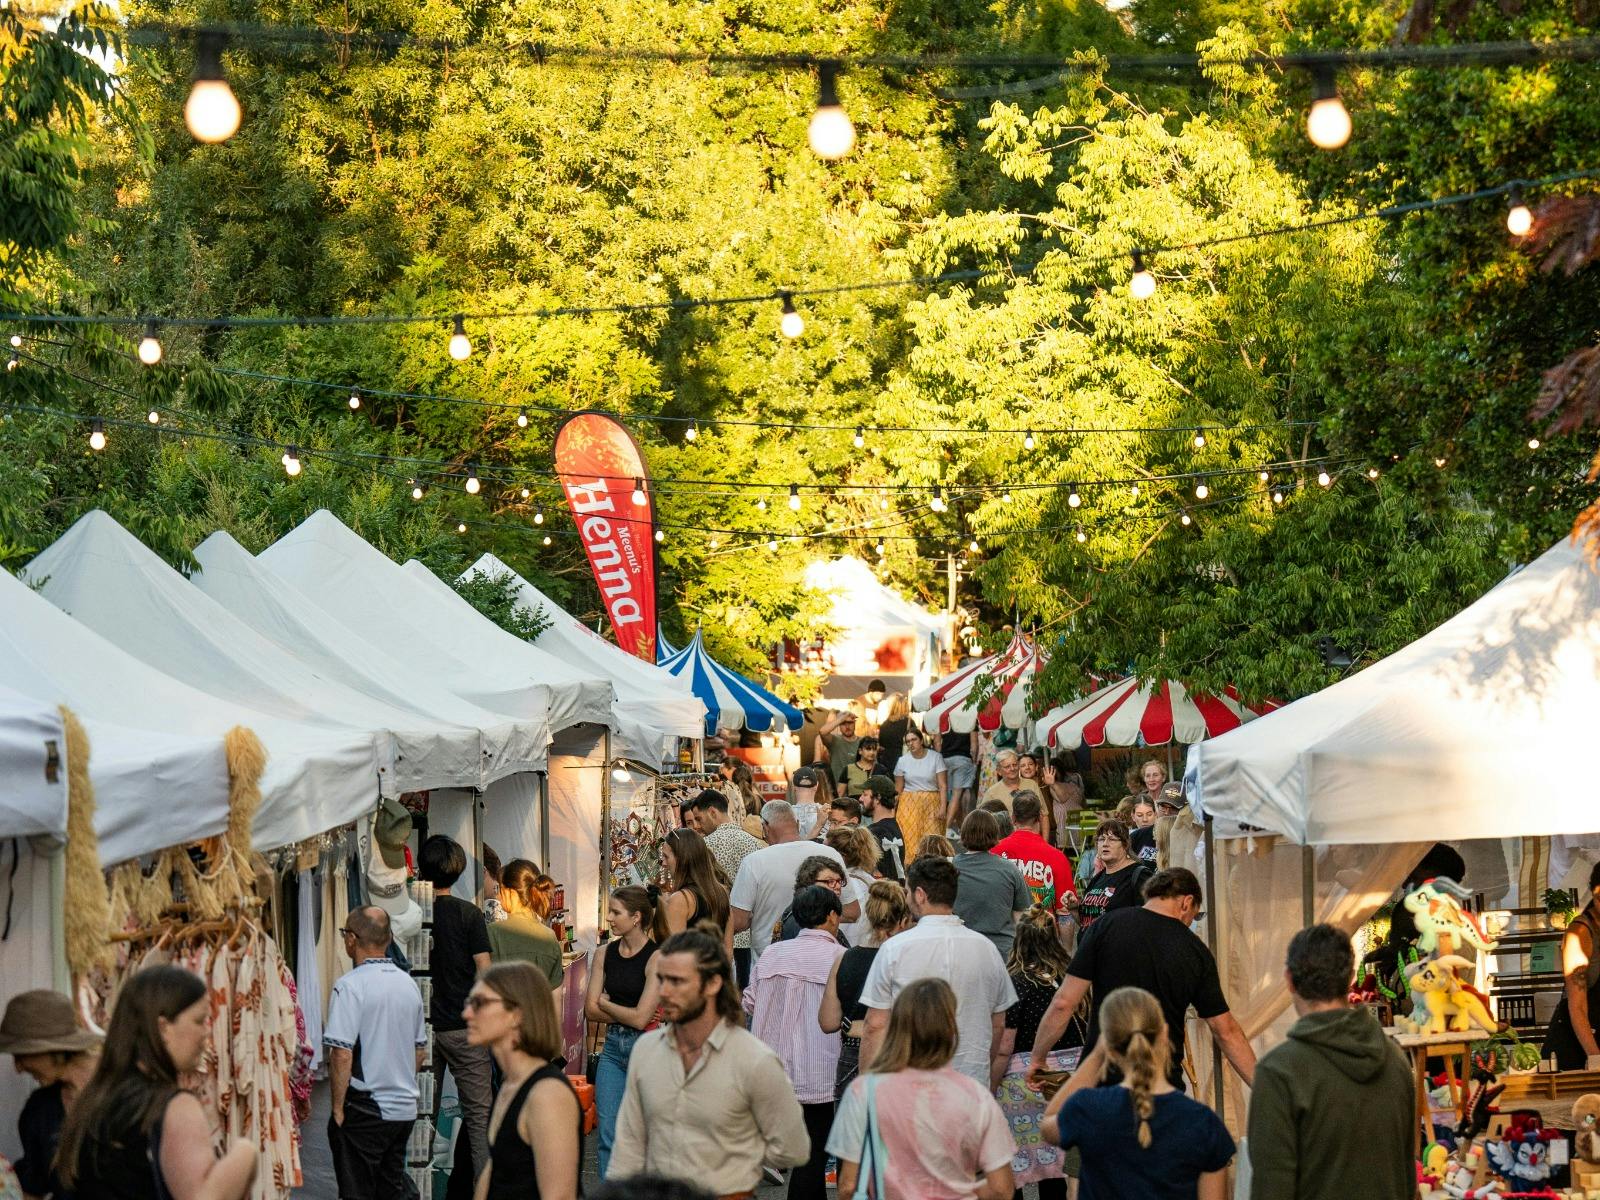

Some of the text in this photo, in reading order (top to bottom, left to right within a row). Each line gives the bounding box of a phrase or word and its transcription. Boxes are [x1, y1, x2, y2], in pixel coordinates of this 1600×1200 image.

[567, 478, 644, 627] Henna
[617, 526, 641, 574] Meenu's
[1007, 858, 1054, 889] MBO
